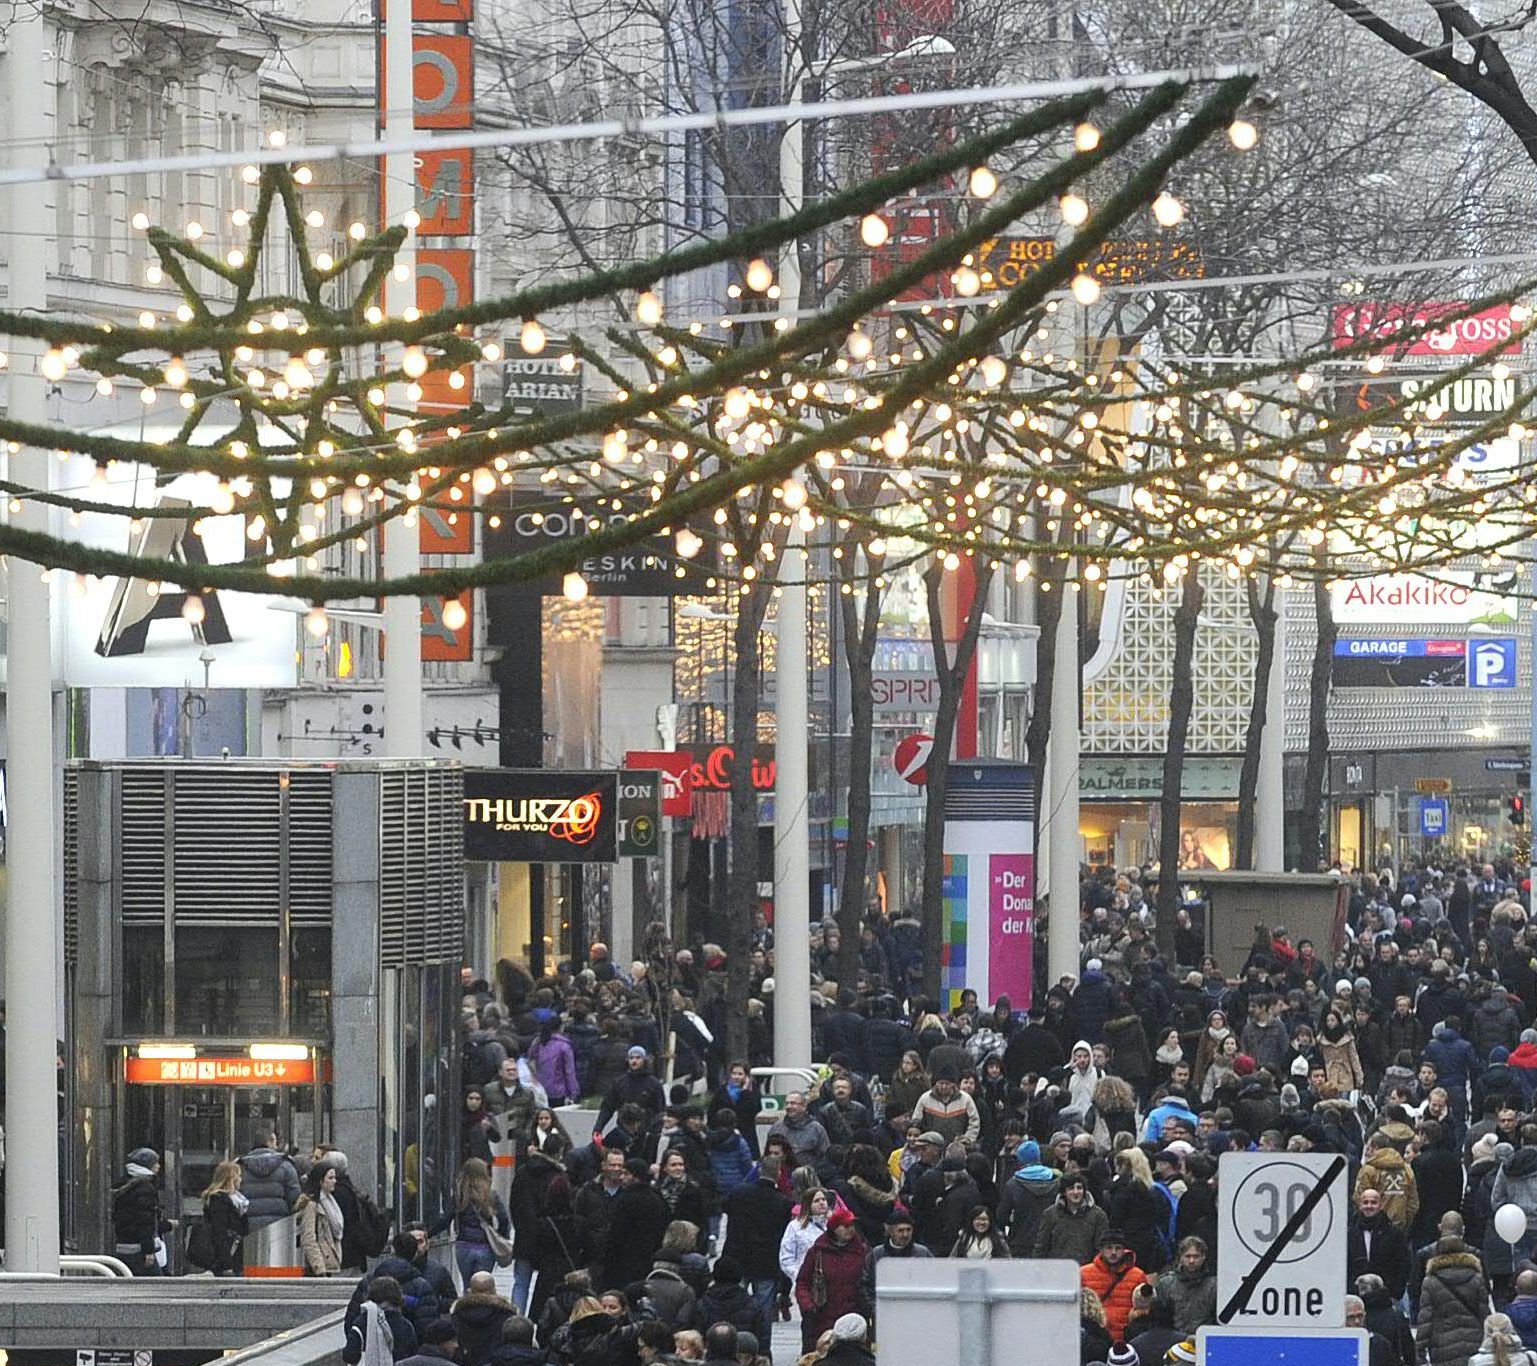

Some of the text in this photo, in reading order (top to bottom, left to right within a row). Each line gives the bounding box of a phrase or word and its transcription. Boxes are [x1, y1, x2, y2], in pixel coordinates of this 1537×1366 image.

[1344, 579, 1468, 605] Akakiko
[1350, 641, 1407, 654] GARAGE
[463, 798, 593, 823] THURZO
[495, 824, 548, 832] FOR YOU
[1002, 917, 1025, 934] der
[217, 1062, 273, 1077] Linie U3
[1253, 1182, 1313, 1243] 30
